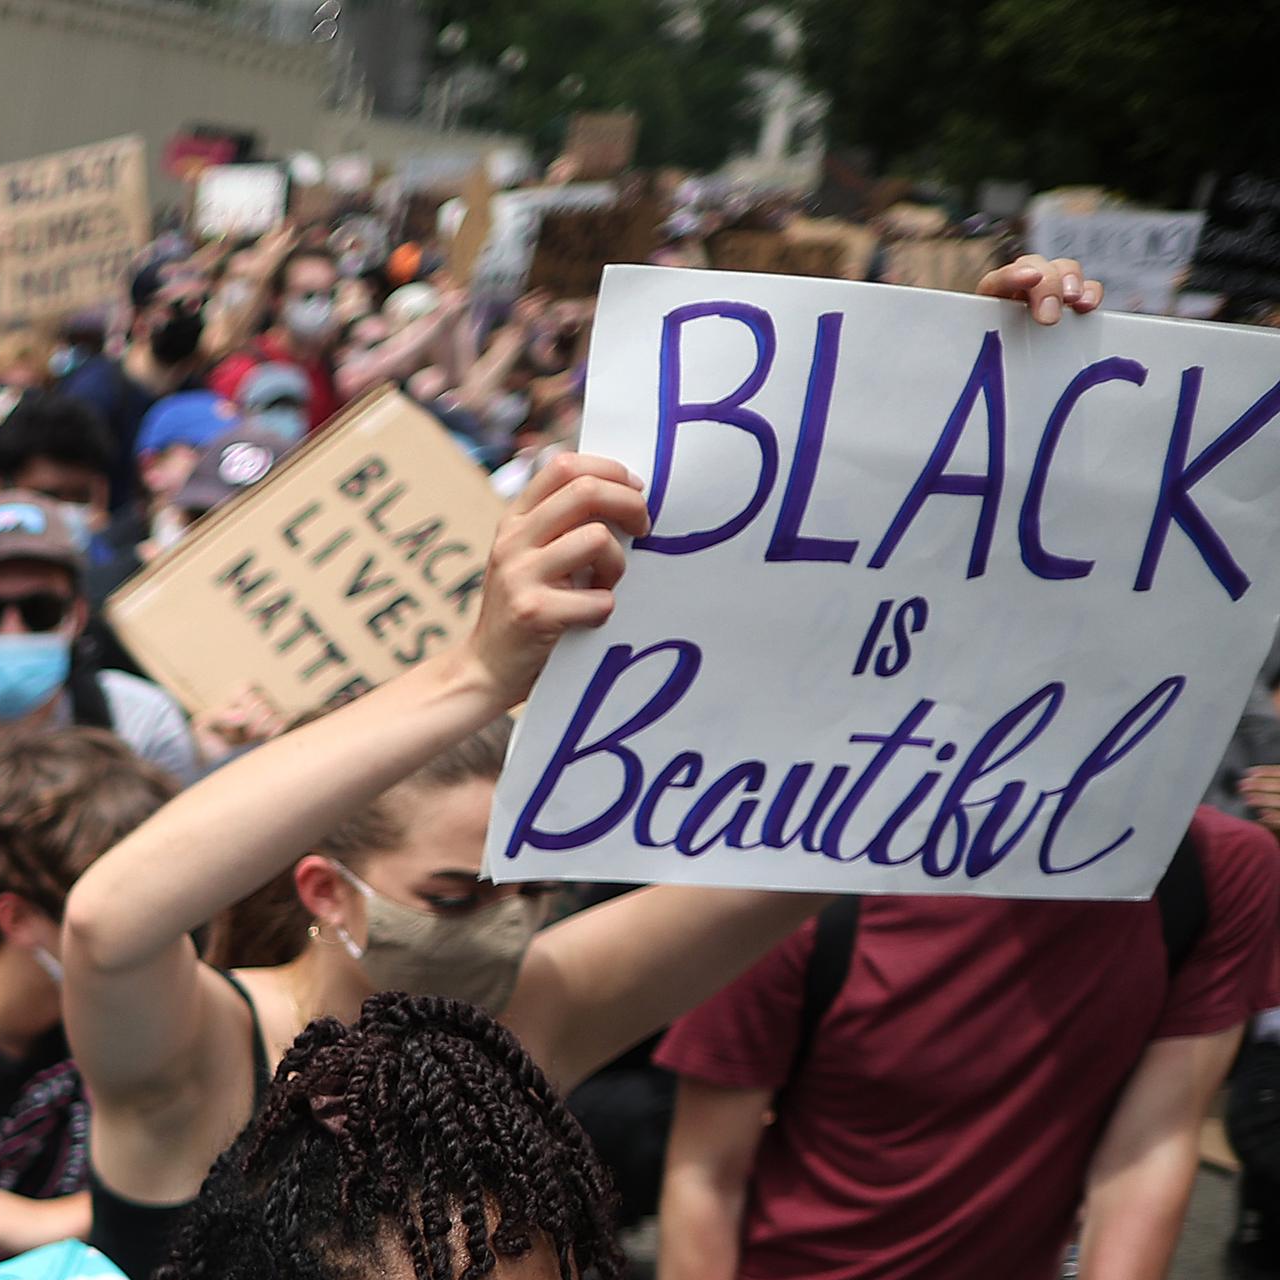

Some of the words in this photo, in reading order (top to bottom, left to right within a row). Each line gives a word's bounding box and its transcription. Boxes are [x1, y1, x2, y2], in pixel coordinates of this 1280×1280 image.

[632, 300, 1280, 602] BLACK
[281, 502, 447, 665] LIVES
[337, 456, 486, 616] BLACK
[851, 596, 929, 678] IS
[504, 639, 1187, 879] Beautiful
